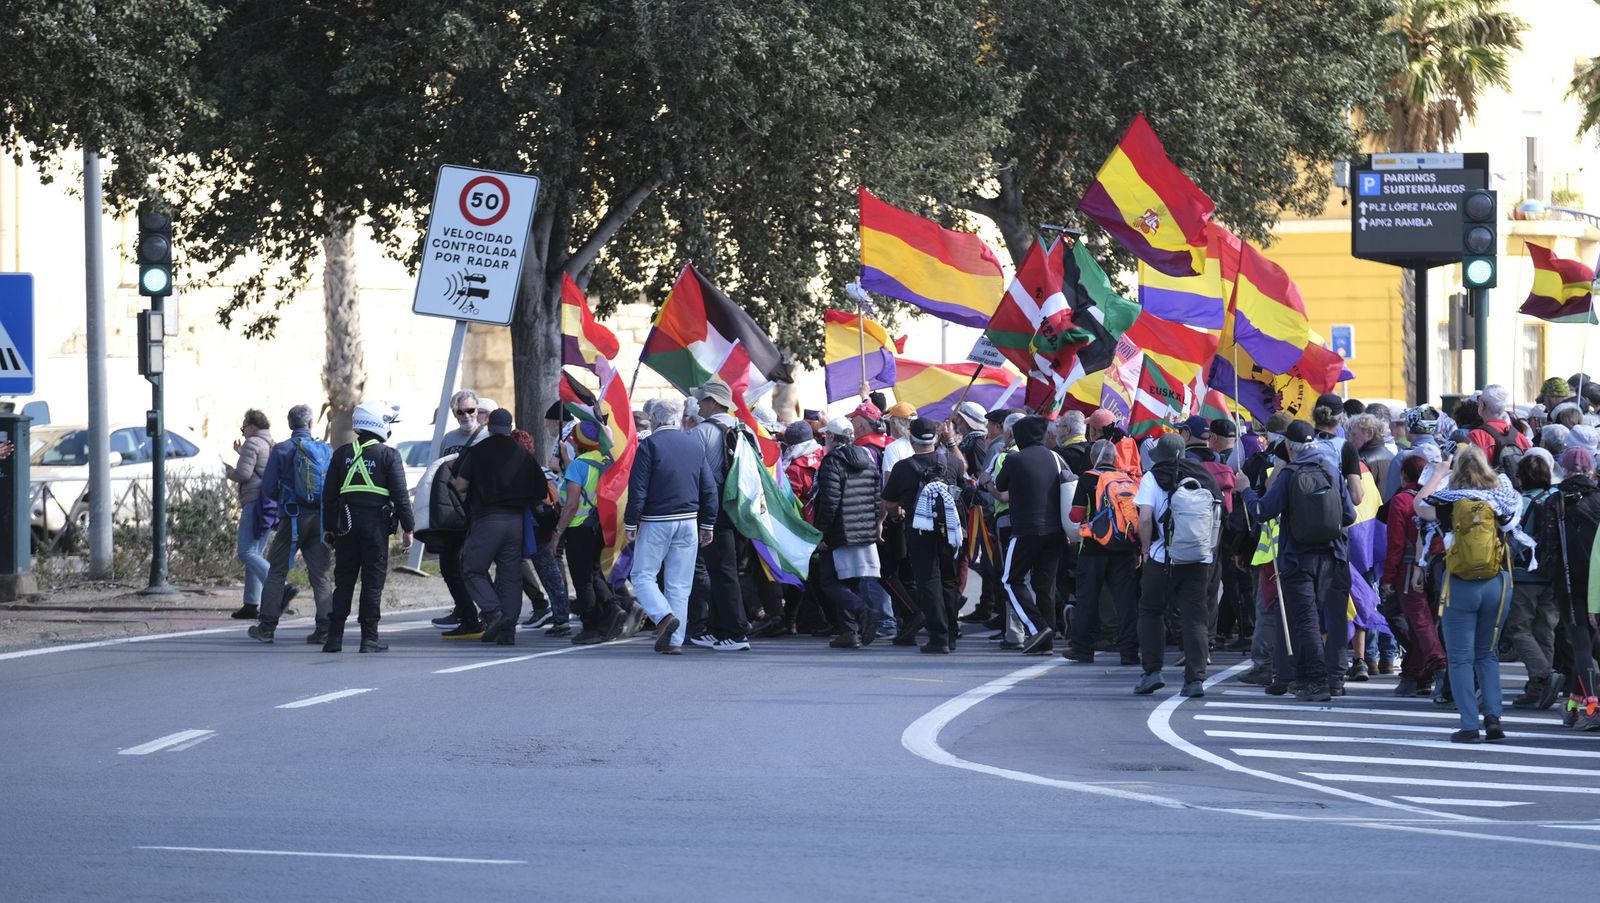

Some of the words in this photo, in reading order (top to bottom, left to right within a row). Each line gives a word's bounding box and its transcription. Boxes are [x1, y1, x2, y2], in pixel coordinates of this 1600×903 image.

[1383, 173, 1436, 183] PARKINGS
[1364, 177, 1376, 193] P
[1383, 184, 1466, 194] SUBTERRÁNEOS
[470, 191, 499, 210] 50
[1368, 202, 1388, 212] PLZ
[1389, 201, 1418, 212] LÓPEZ
[1420, 201, 1457, 212] FALCÓN
[1368, 218, 1392, 227] APK2
[1395, 218, 1433, 227] RAMBLA
[443, 226, 513, 245] VELOCIDAD
[432, 238, 517, 258] CONTROLADA
[435, 252, 460, 264] POR
[467, 256, 510, 270] RADAR
[345, 457, 376, 468] PCIA
